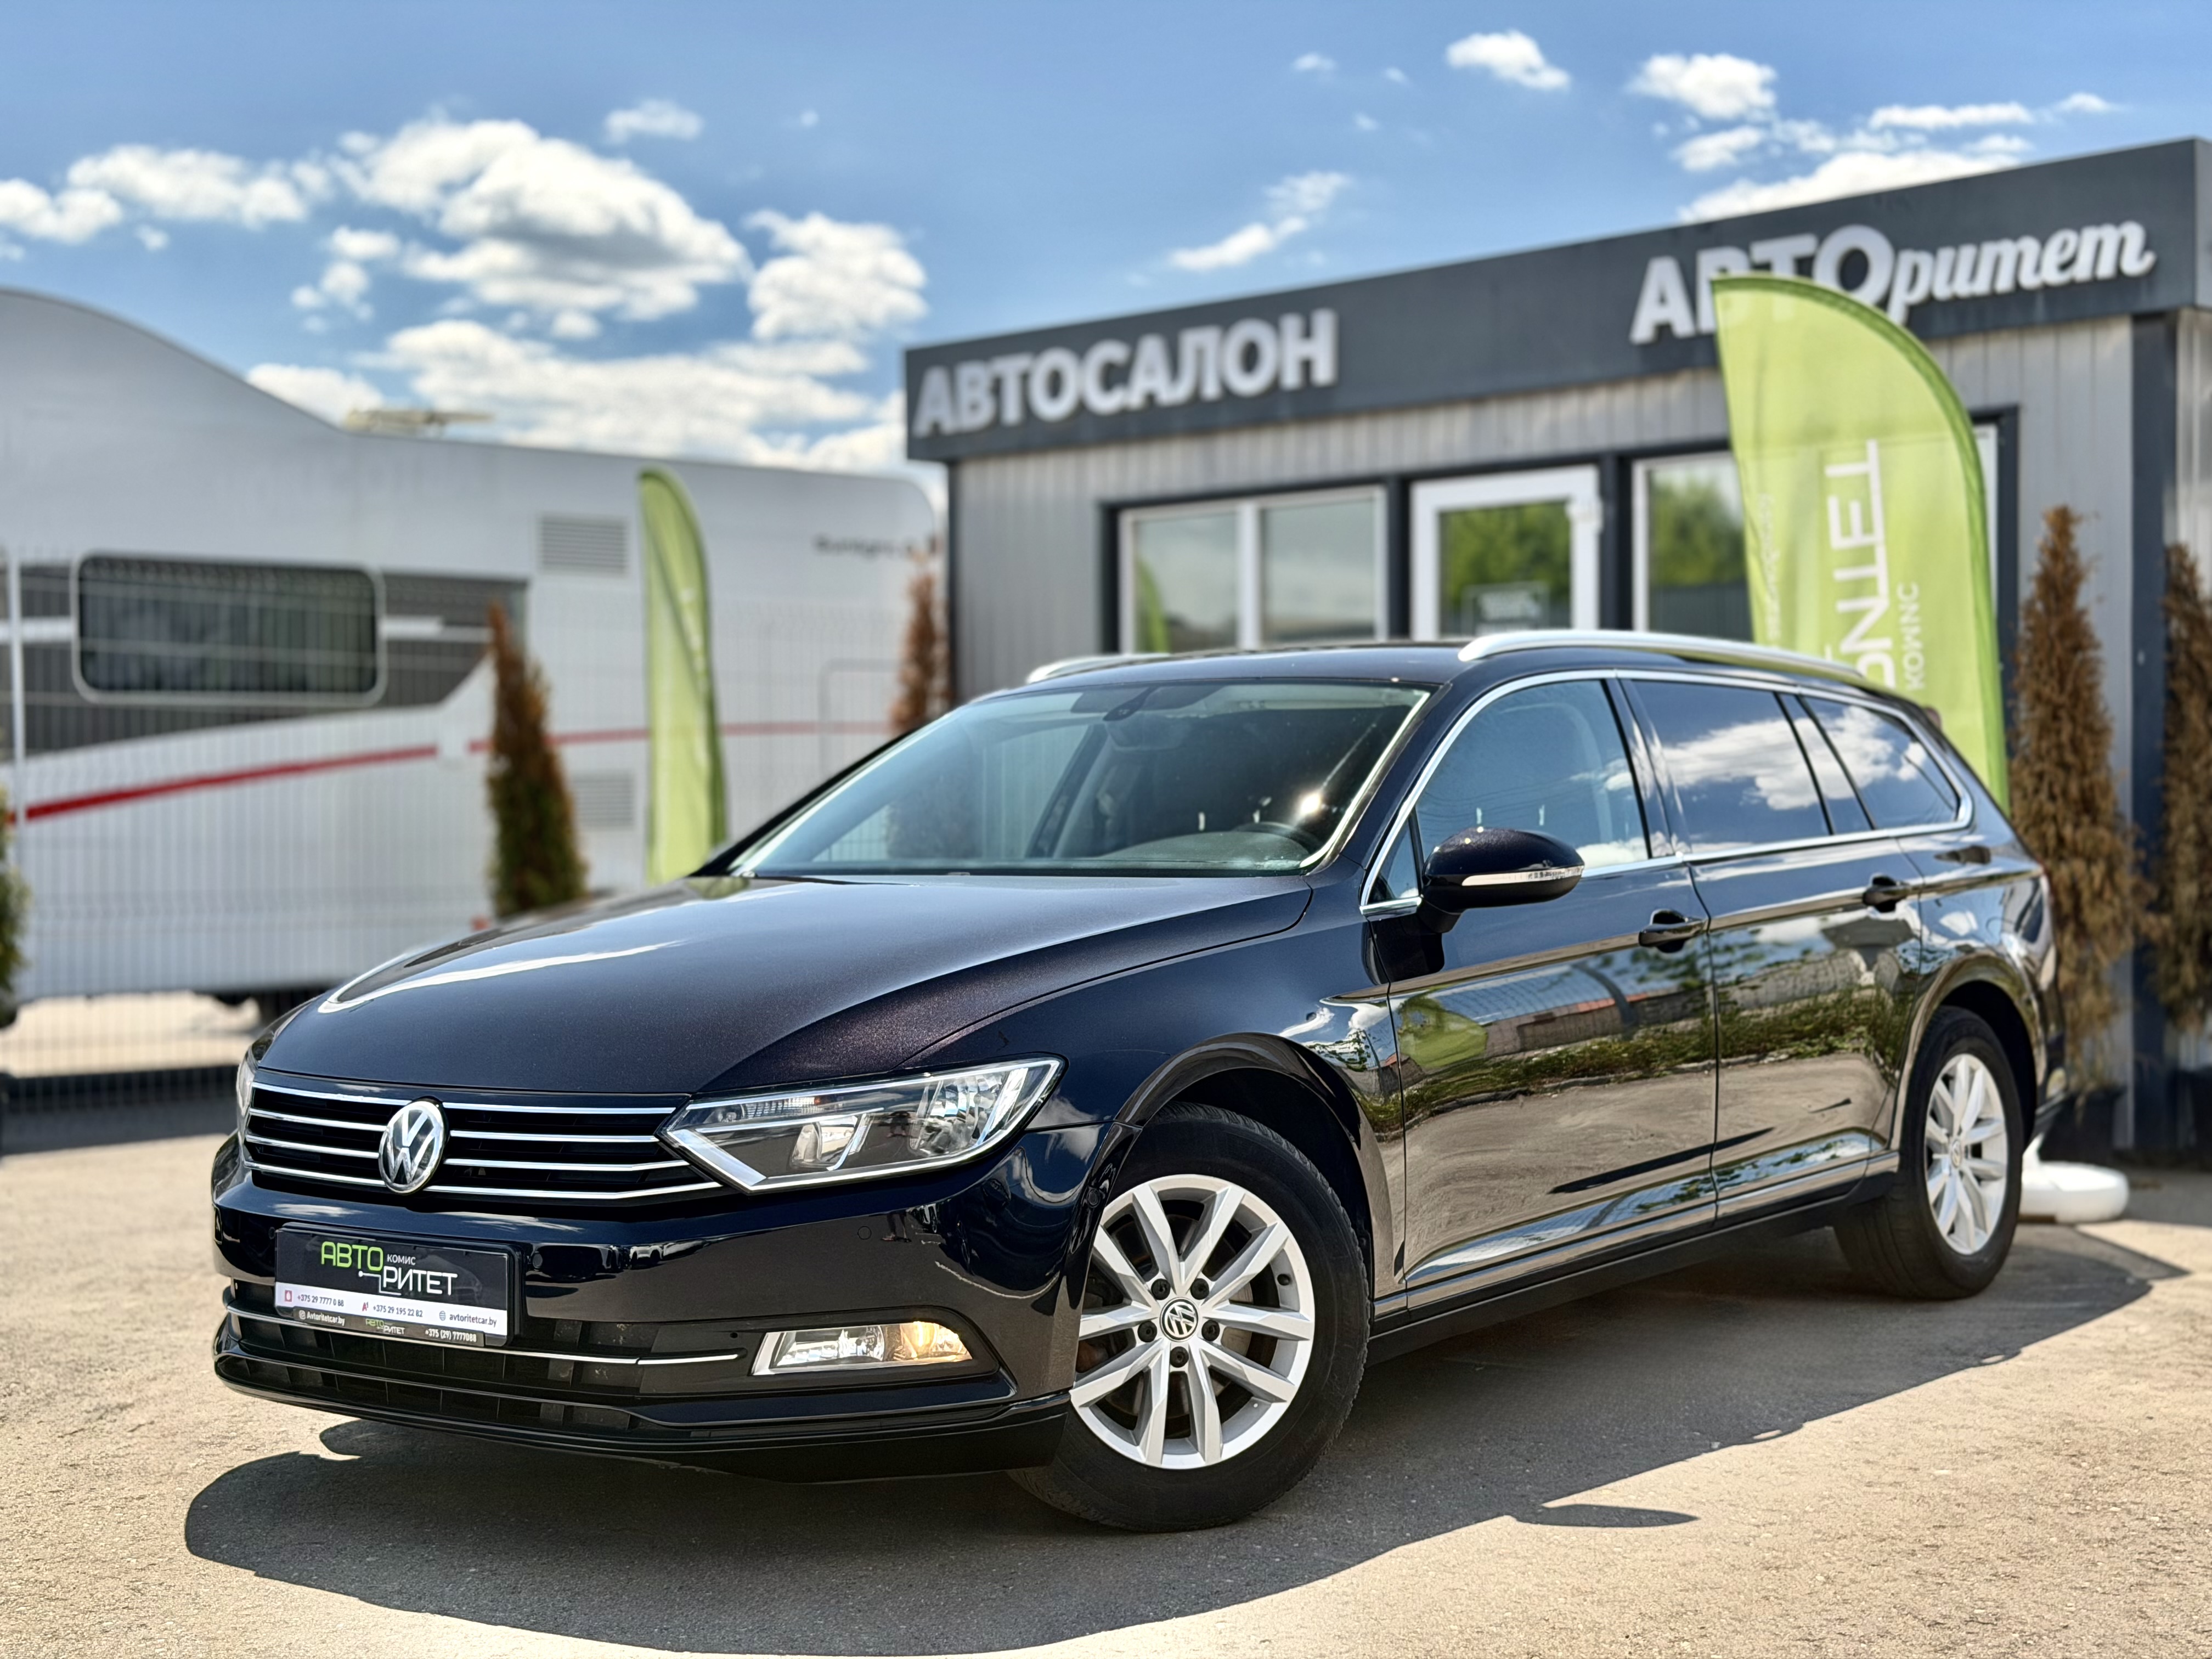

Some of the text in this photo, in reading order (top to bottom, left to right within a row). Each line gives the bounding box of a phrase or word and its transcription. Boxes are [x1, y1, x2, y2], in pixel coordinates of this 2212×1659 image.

[911, 308, 1338, 437] АВТОСАЛОН
[321, 1241, 383, 1271] АВТО
[387, 1254, 416, 1266] КОМИС
[383, 1266, 458, 1296] РИТЕТ
[297, 1294, 311, 1302] +375
[319, 1296, 332, 1306] 7777
[373, 1305, 386, 1313] +375
[396, 1307, 407, 1316] 195
[449, 1313, 497, 1328] avtoritetcar.by
[440, 1329, 452, 1340] (29)
